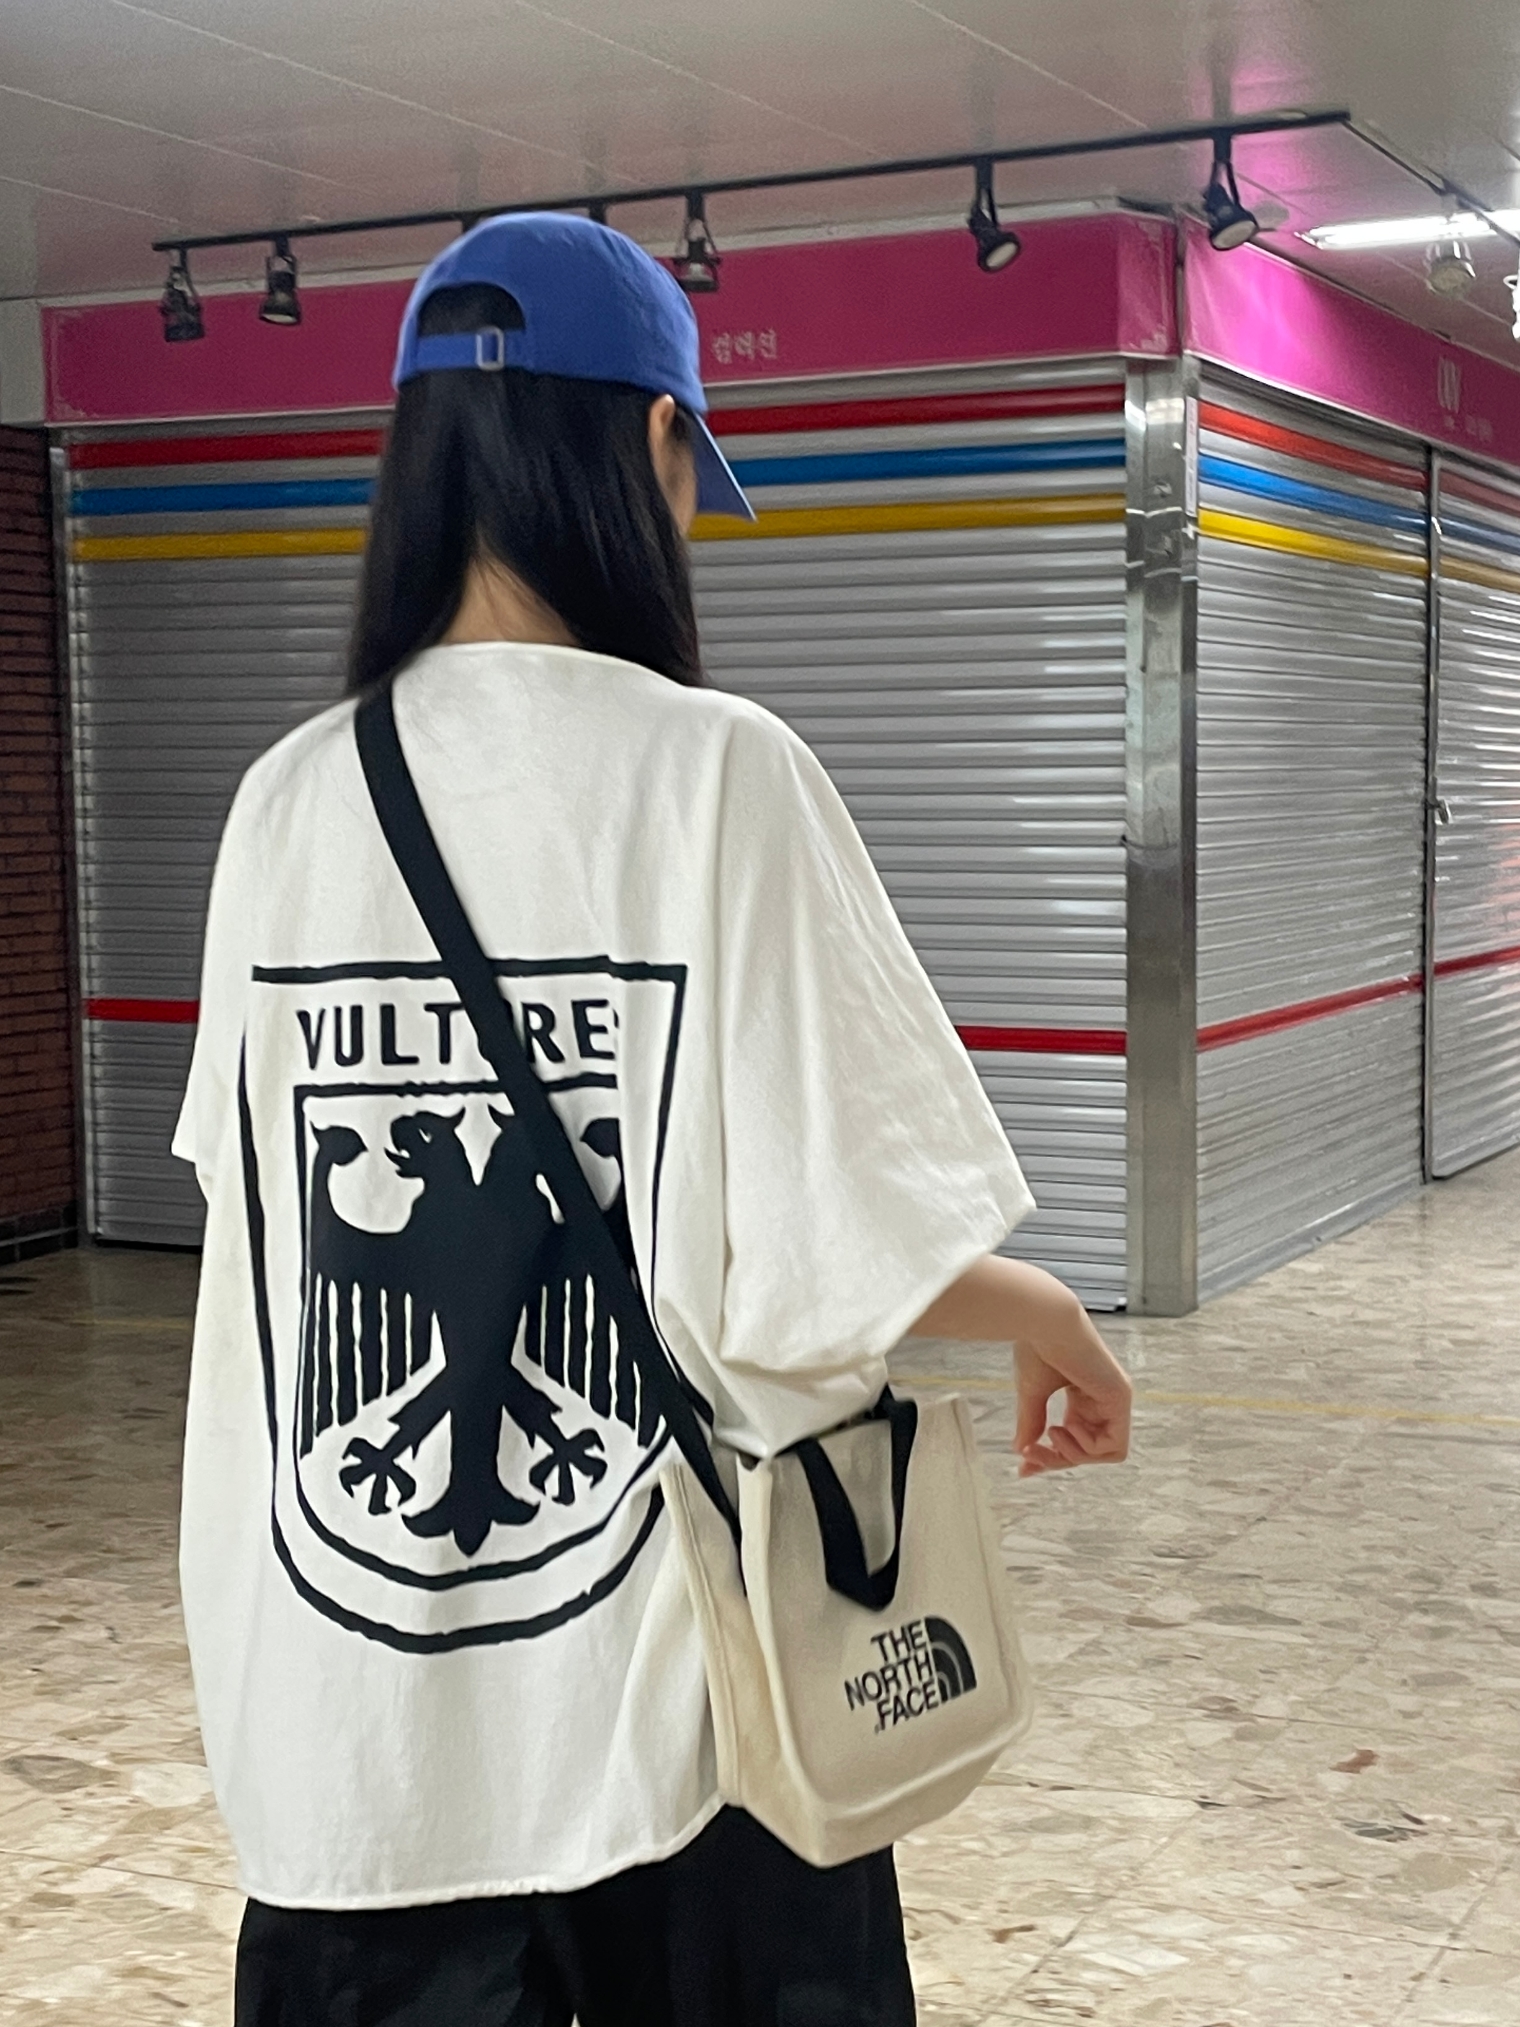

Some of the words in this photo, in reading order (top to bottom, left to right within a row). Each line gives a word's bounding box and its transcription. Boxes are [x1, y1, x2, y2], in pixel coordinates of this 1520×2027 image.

[870, 1619, 927, 1662] THE
[844, 1650, 933, 1711] NORTH
[876, 1678, 940, 1731] FACE
